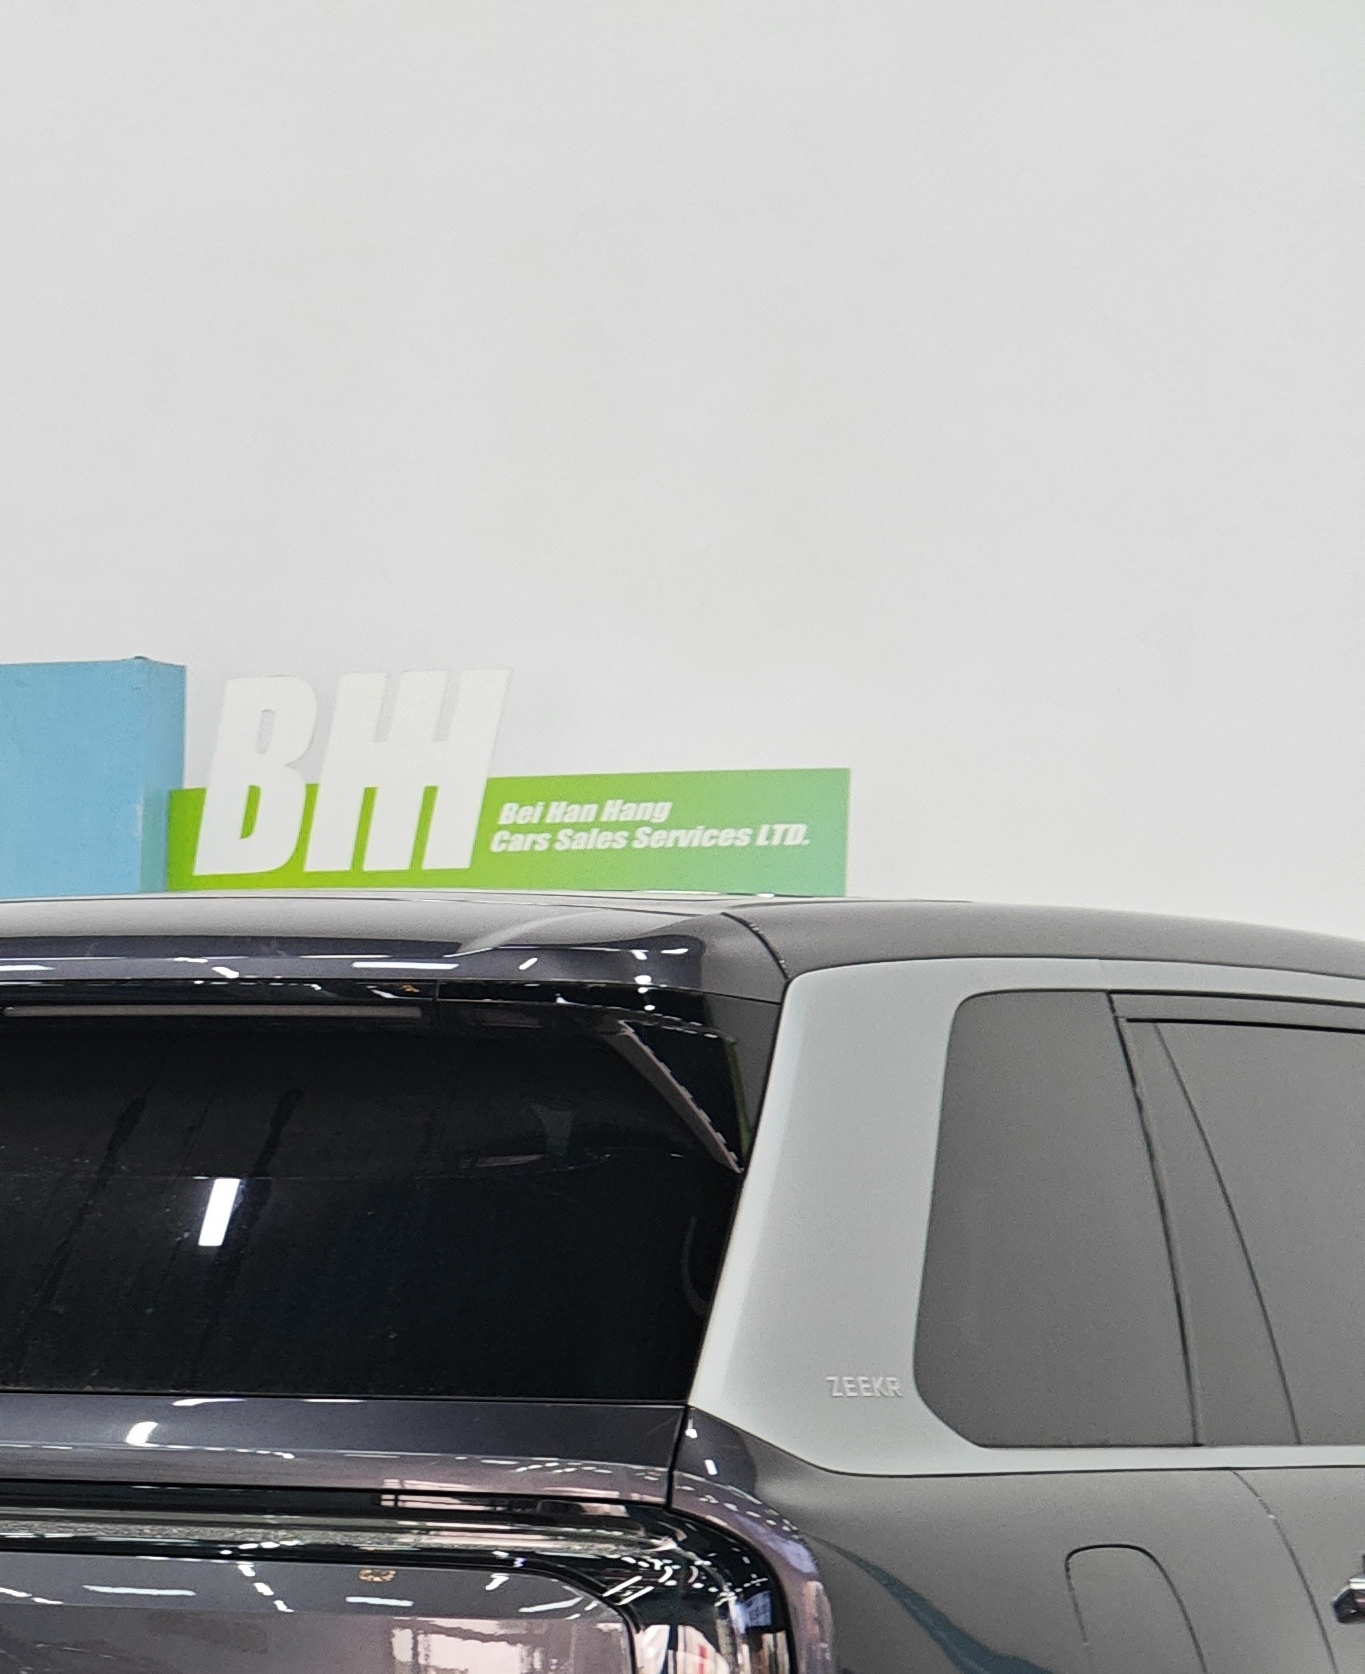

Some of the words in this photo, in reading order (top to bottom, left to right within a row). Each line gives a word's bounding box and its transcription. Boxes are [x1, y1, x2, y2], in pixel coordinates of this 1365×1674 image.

[497, 801, 545, 825] Bei
[544, 800, 599, 824] Han
[600, 799, 673, 824] Hang
[490, 830, 552, 853] Cars
[554, 828, 629, 851] Sales
[632, 826, 753, 849] Services
[755, 823, 812, 846] LTD.
[825, 1375, 904, 1398] ZEEKR
